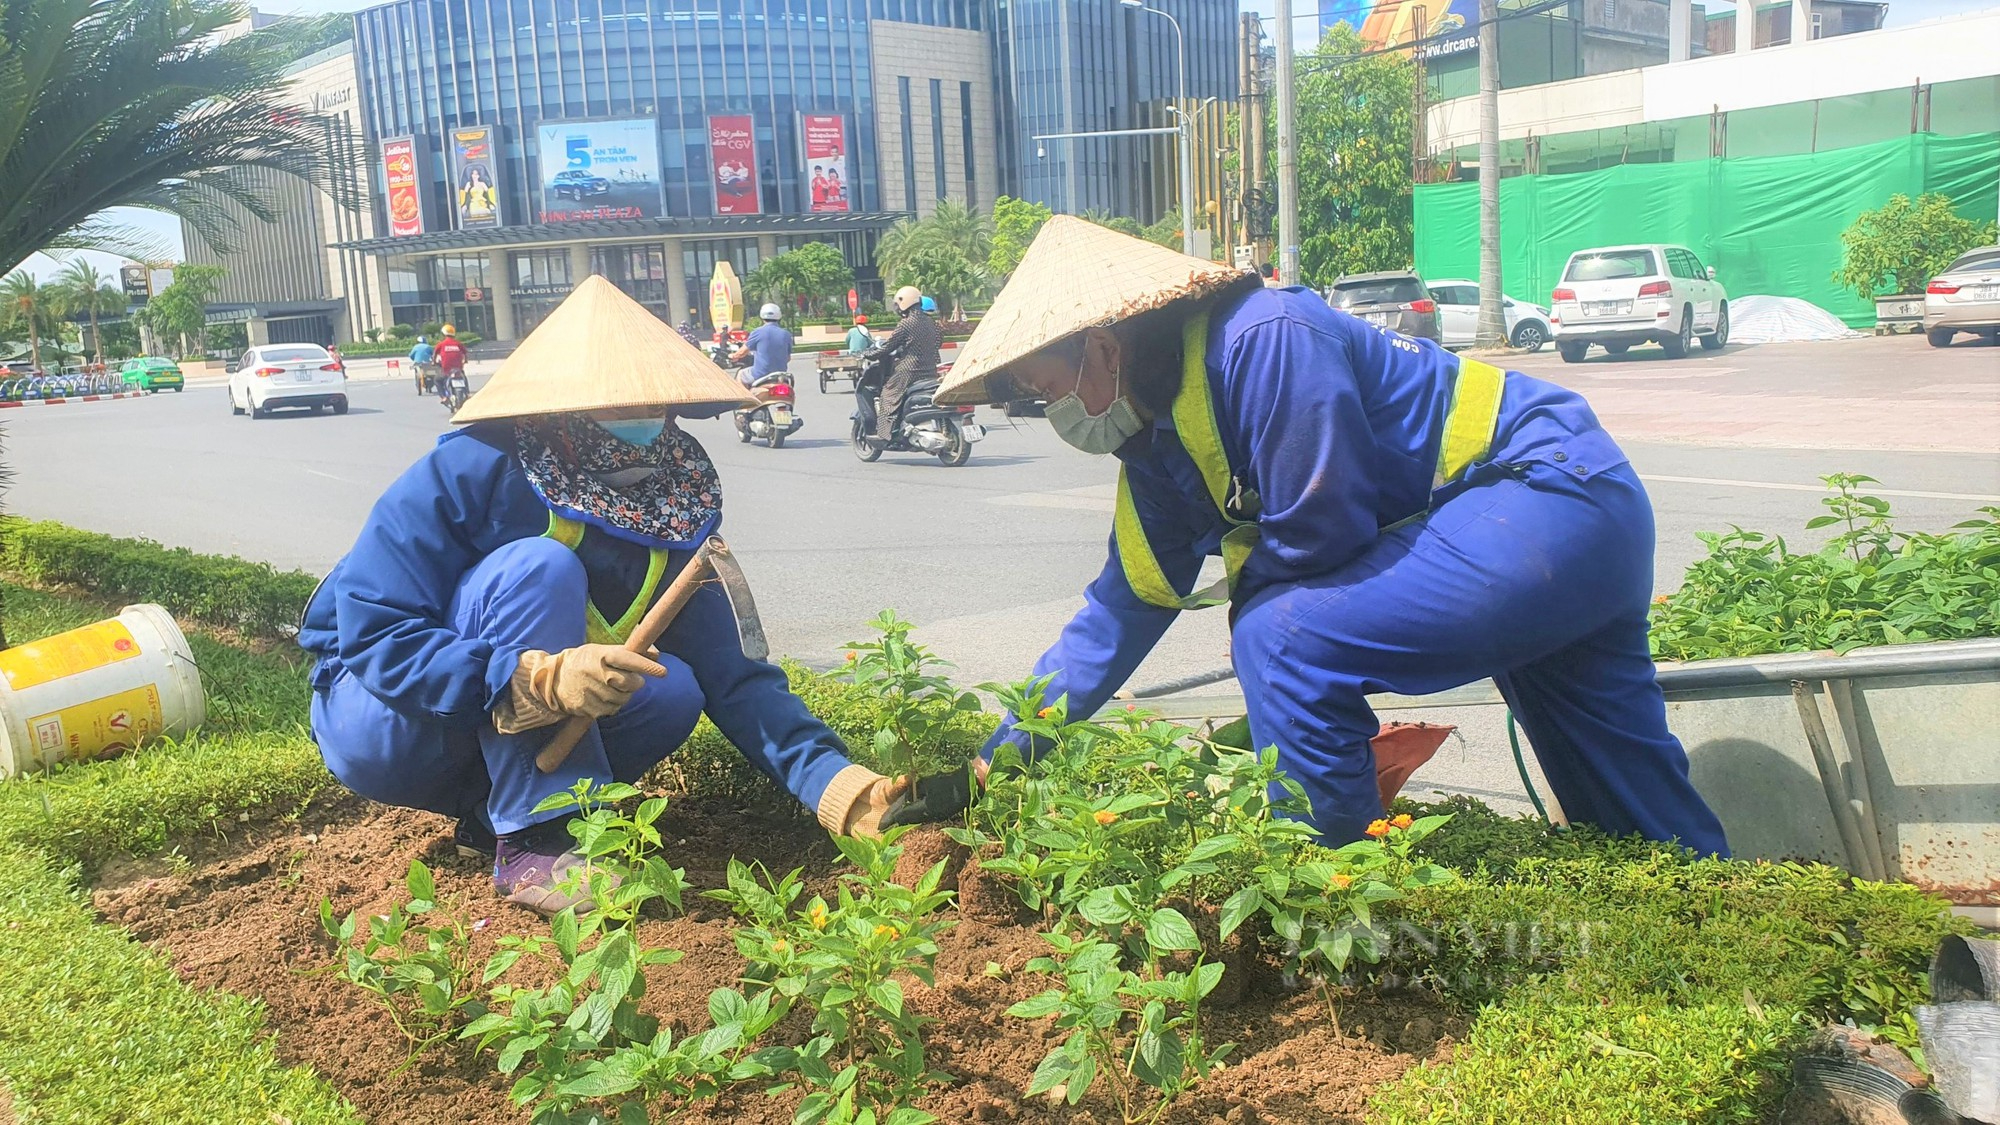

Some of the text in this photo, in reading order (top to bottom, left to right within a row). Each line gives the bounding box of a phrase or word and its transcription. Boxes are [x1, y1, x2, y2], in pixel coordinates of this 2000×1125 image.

[727, 139, 751, 150] CGV
[593, 148, 606, 156] AN
[597, 206, 643, 219] PLAZA
[1389, 338, 1420, 354] CÔN
